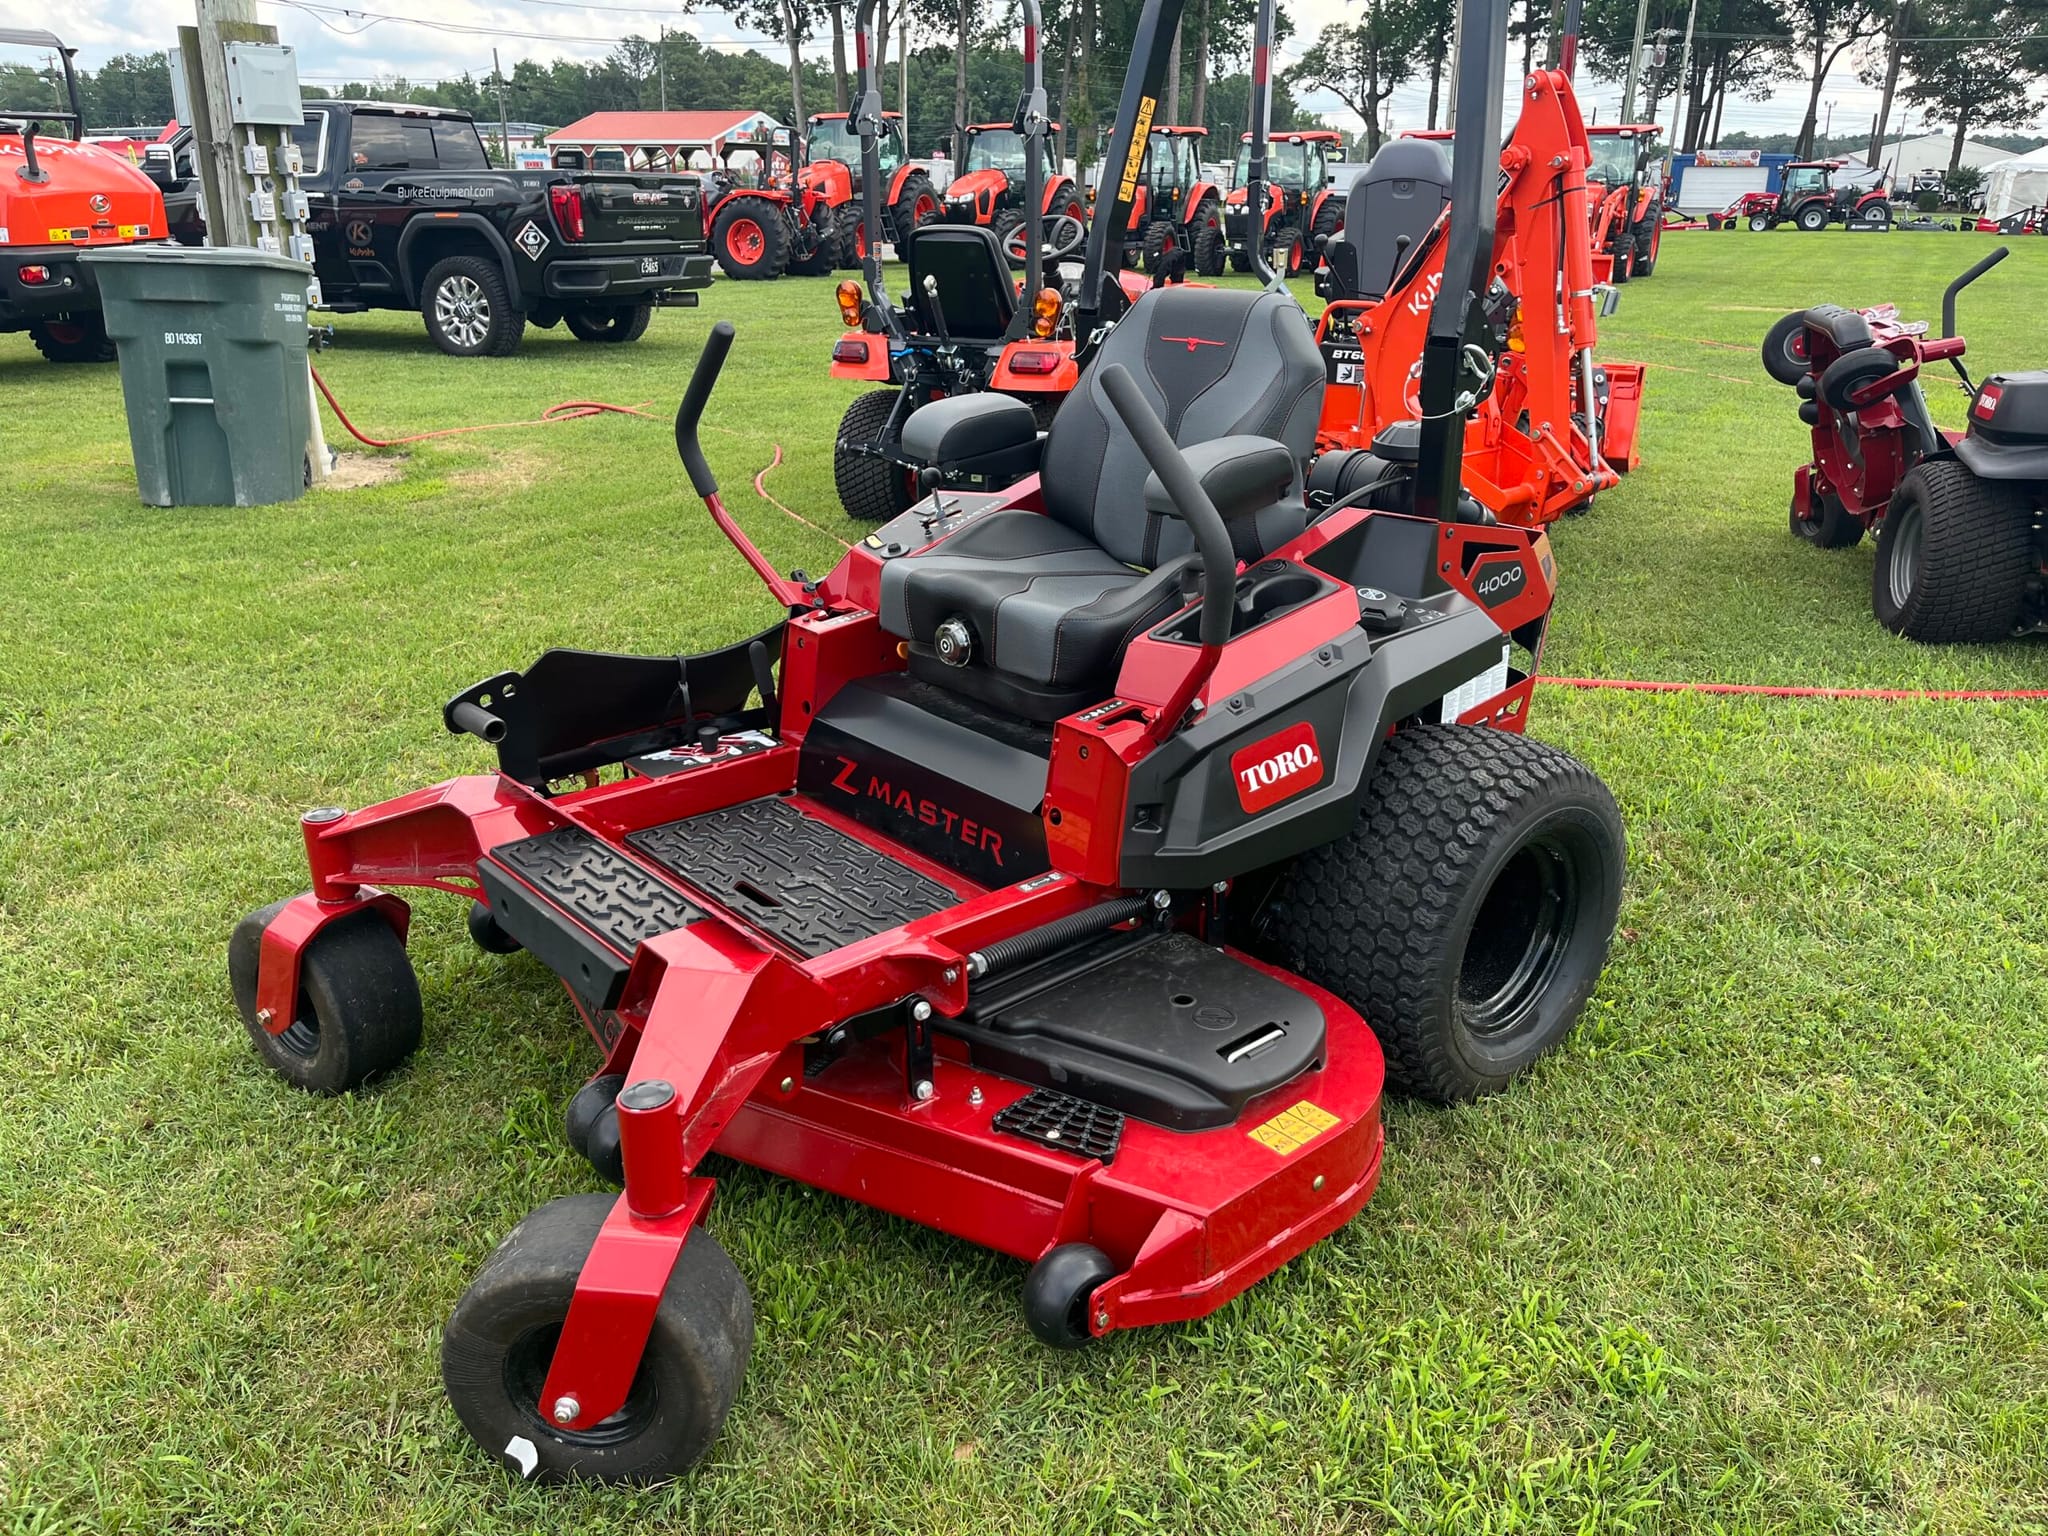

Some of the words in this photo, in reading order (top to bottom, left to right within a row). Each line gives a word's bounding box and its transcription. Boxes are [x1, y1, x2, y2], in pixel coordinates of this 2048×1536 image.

[397, 186, 494, 199] BurkeEquipment.com
[633, 193, 669, 205] GMC
[1478, 566, 1522, 595] 4000
[1240, 743, 1314, 793] TORO
[831, 754, 860, 796] Z
[866, 776, 1004, 867] MASTER
